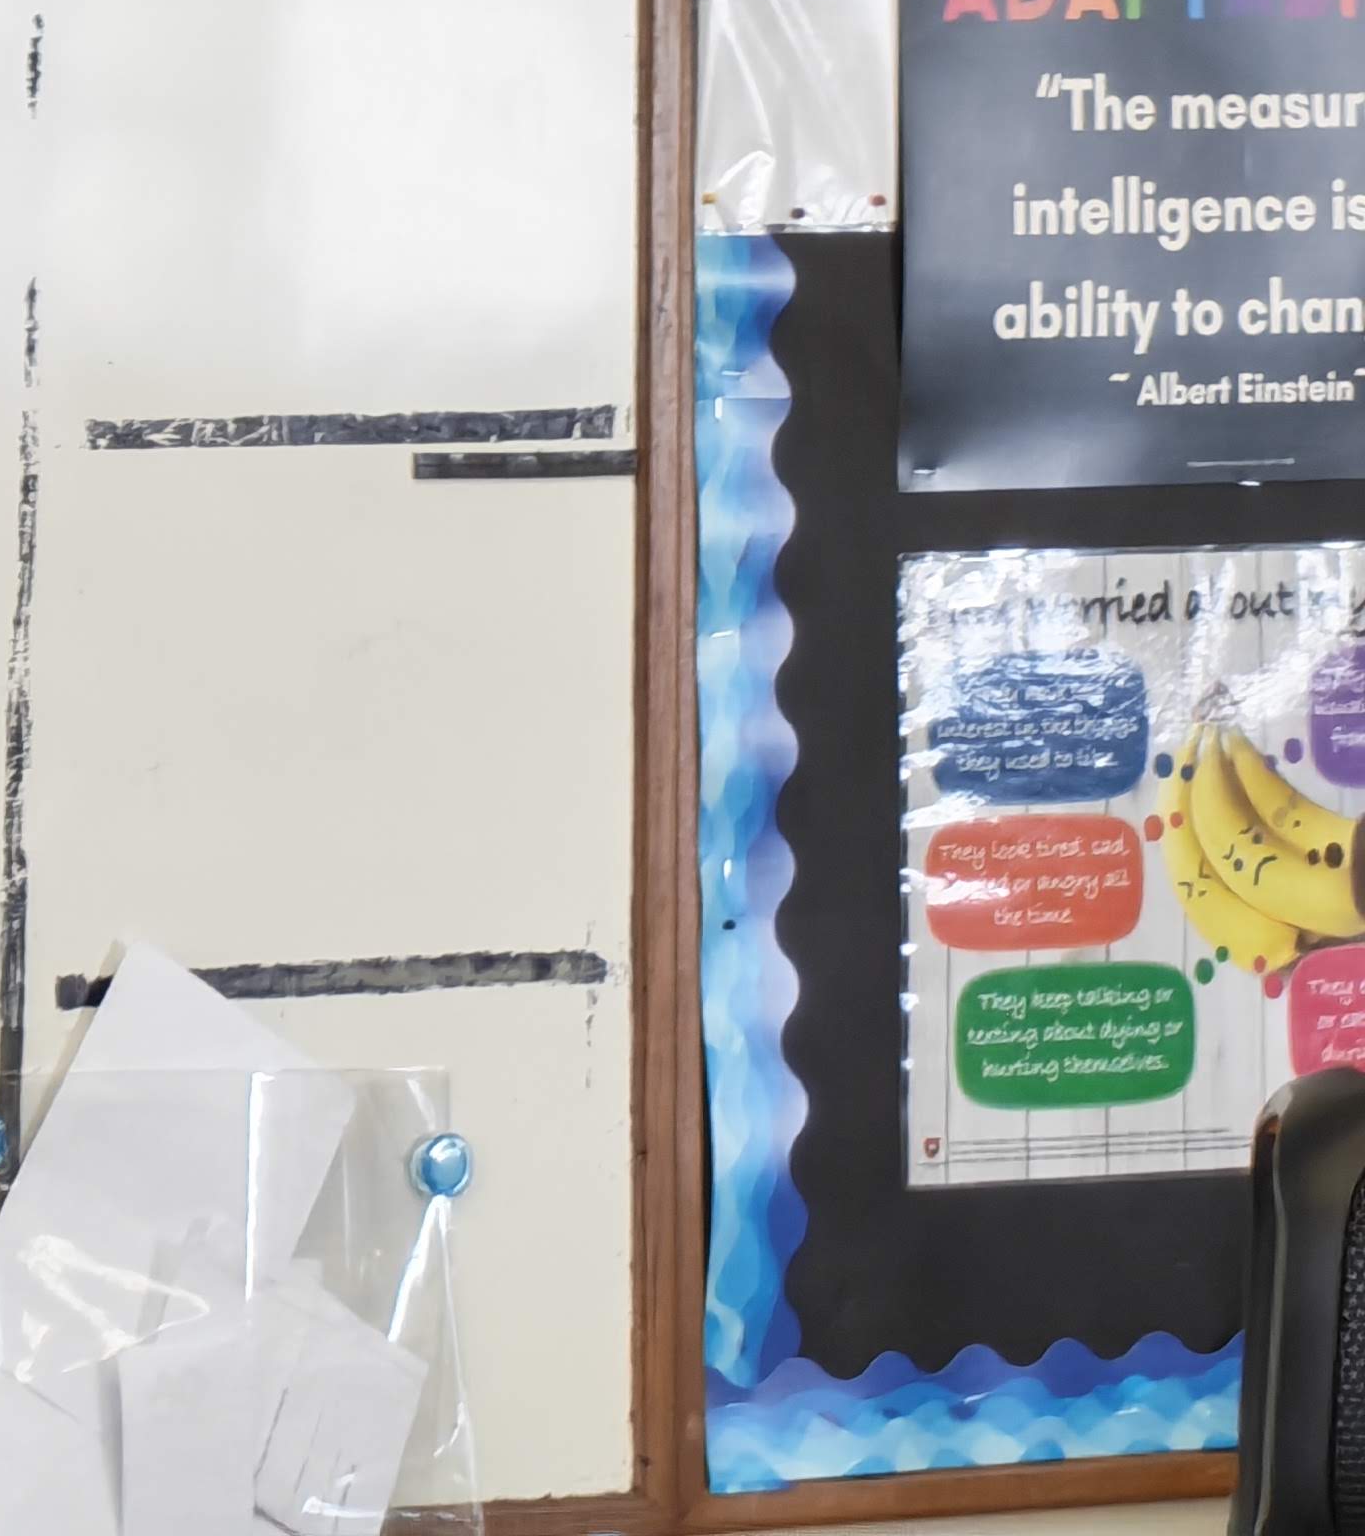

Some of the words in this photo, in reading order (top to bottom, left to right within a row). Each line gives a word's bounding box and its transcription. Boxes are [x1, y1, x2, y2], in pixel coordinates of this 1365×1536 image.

[1171, 91, 1365, 130] measur
[1012, 174, 1317, 252] intelligence
[1331, 177, 1365, 232] is
[993, 278, 1162, 356] ability
[1171, 288, 1225, 336] to
[1237, 275, 1365, 337] chan
[938, 842, 987, 871] They
[991, 839, 1033, 860] look
[1036, 872, 1101, 900] angry
[993, 905, 1024, 927] the
[1026, 901, 1074, 925] time
[977, 991, 1027, 1020] They
[1030, 988, 1074, 1015] keep
[1077, 983, 1152, 1012] talking
[1154, 987, 1175, 1005] or
[966, 1020, 1040, 1050] texting
[1043, 1019, 1097, 1043] about
[1099, 1015, 1163, 1050] dying
[1164, 1020, 1185, 1038] or
[982, 1051, 1061, 1083] hurting
